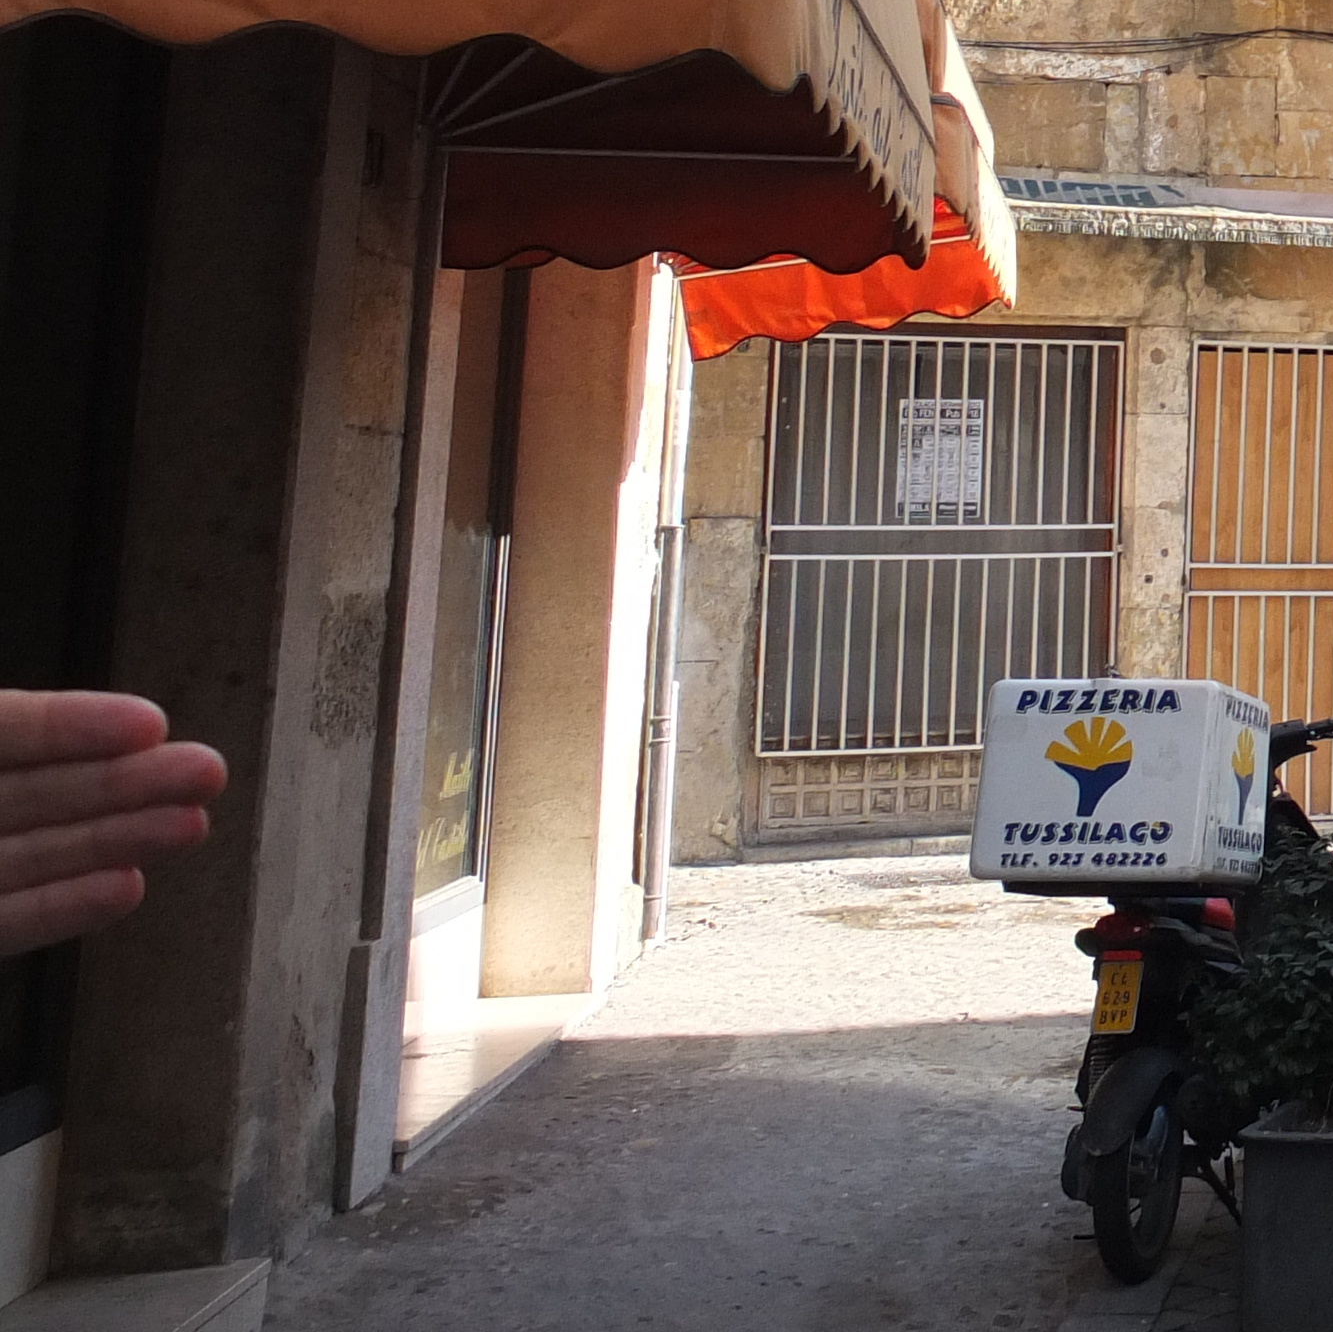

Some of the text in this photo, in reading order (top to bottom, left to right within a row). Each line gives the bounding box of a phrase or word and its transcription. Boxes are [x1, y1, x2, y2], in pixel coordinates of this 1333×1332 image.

[1016, 688, 1181, 714] PIZZERIA
[1225, 698, 1269, 733] PIZZERIA
[1004, 821, 1173, 845] TUSSILAGO
[1000, 852, 1168, 868] TLF. 923 482226
